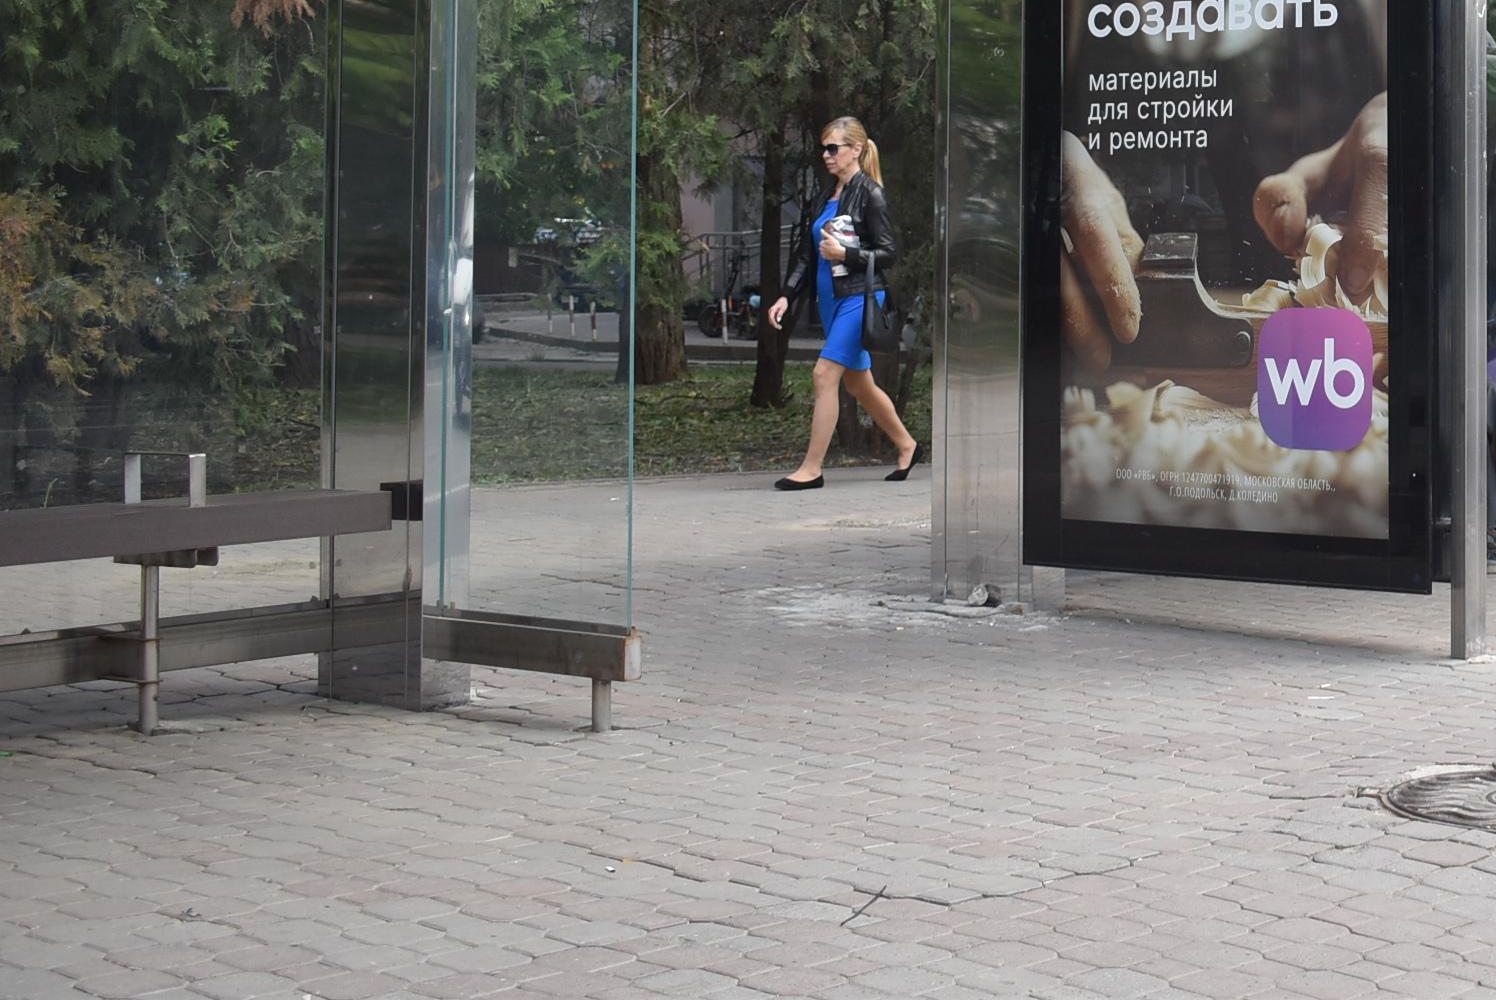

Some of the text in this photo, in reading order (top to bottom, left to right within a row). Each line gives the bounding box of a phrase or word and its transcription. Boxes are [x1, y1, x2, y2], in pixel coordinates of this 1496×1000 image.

[1089, 69, 1218, 95] материалы
[1088, 94, 1233, 125] для стройки
[1088, 129, 1208, 157] и ремонта
[1264, 337, 1365, 410] wb
[1115, 468, 1132, 480] ООО
[1160, 471, 1179, 483] ОГРН
[1244, 475, 1295, 489] МОСКОВСКАЯ
